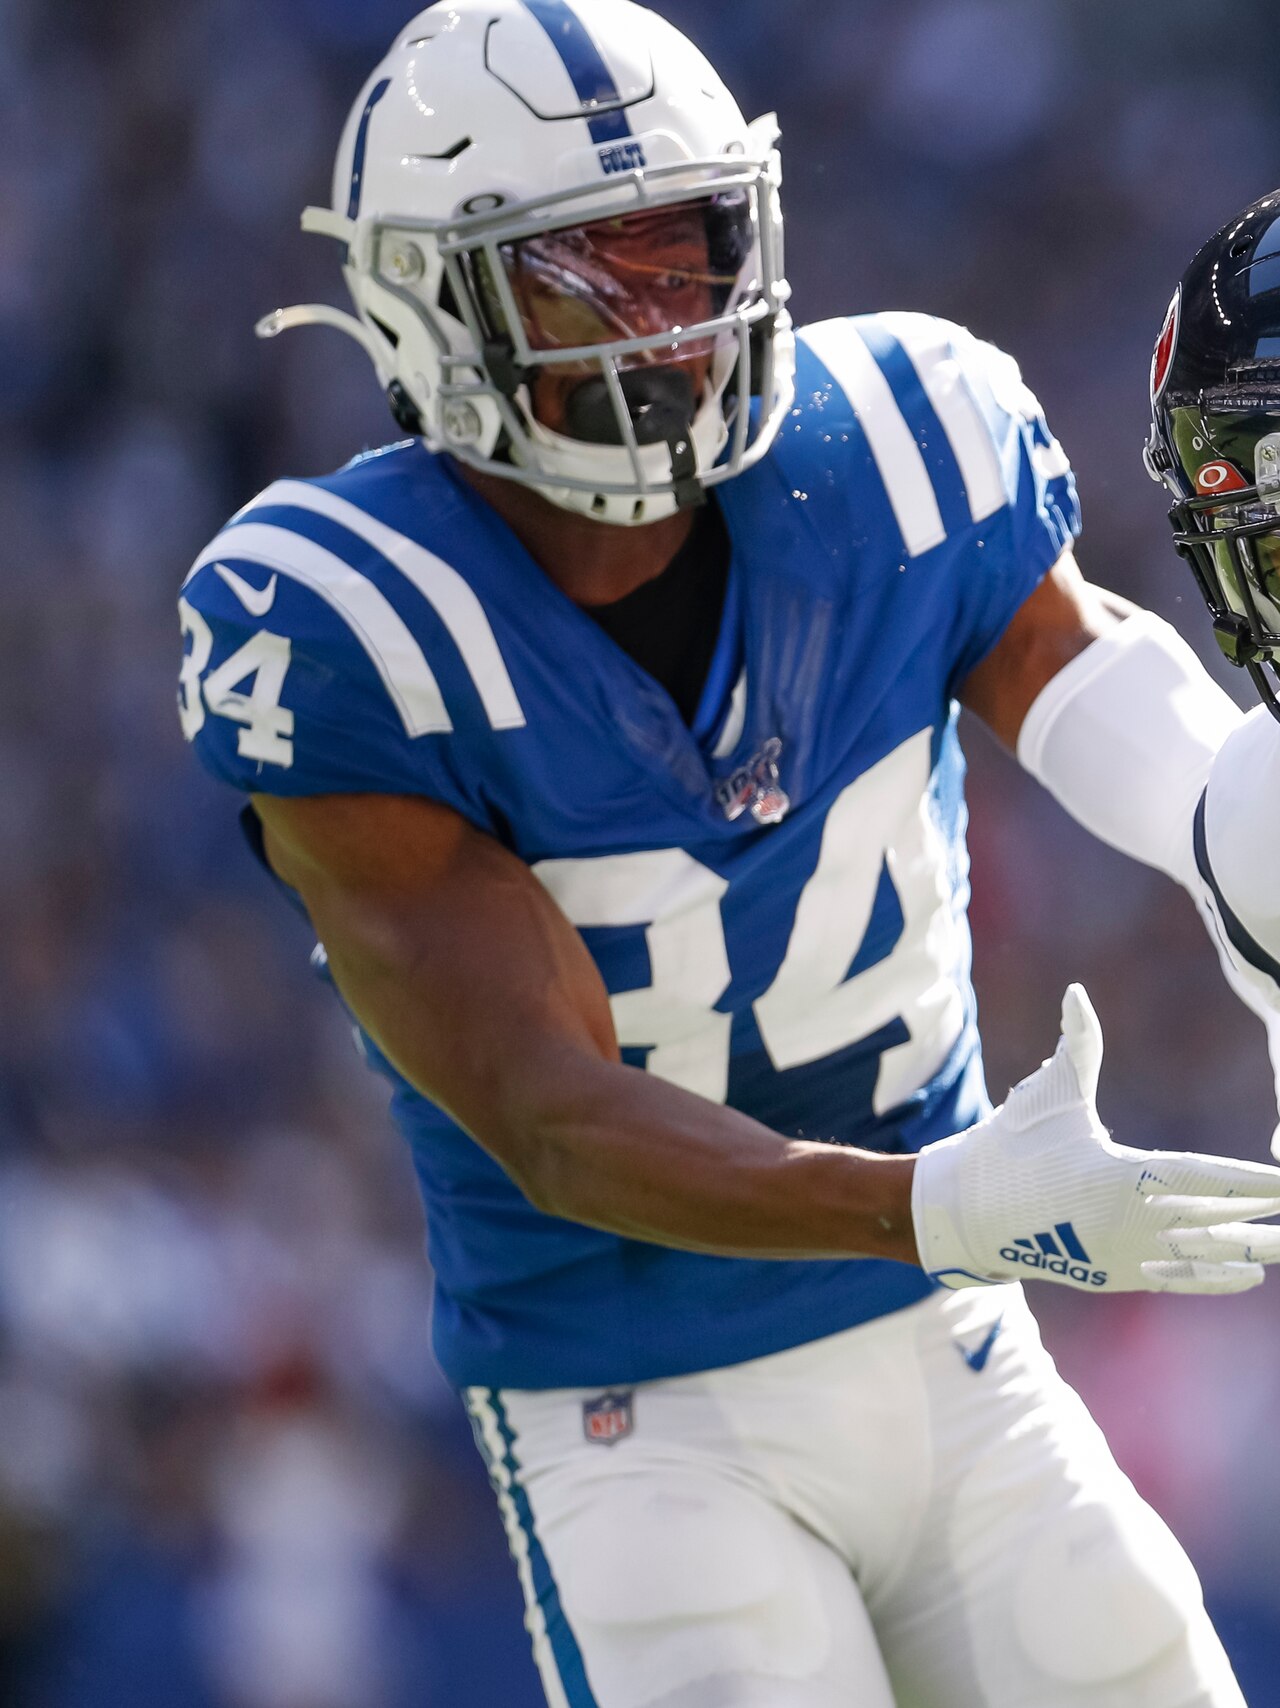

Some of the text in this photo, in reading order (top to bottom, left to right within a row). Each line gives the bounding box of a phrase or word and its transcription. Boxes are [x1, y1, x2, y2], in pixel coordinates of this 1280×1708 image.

[178, 597, 295, 769] 34
[531, 727, 966, 1118] 34
[999, 1246, 1108, 1287] adidas
